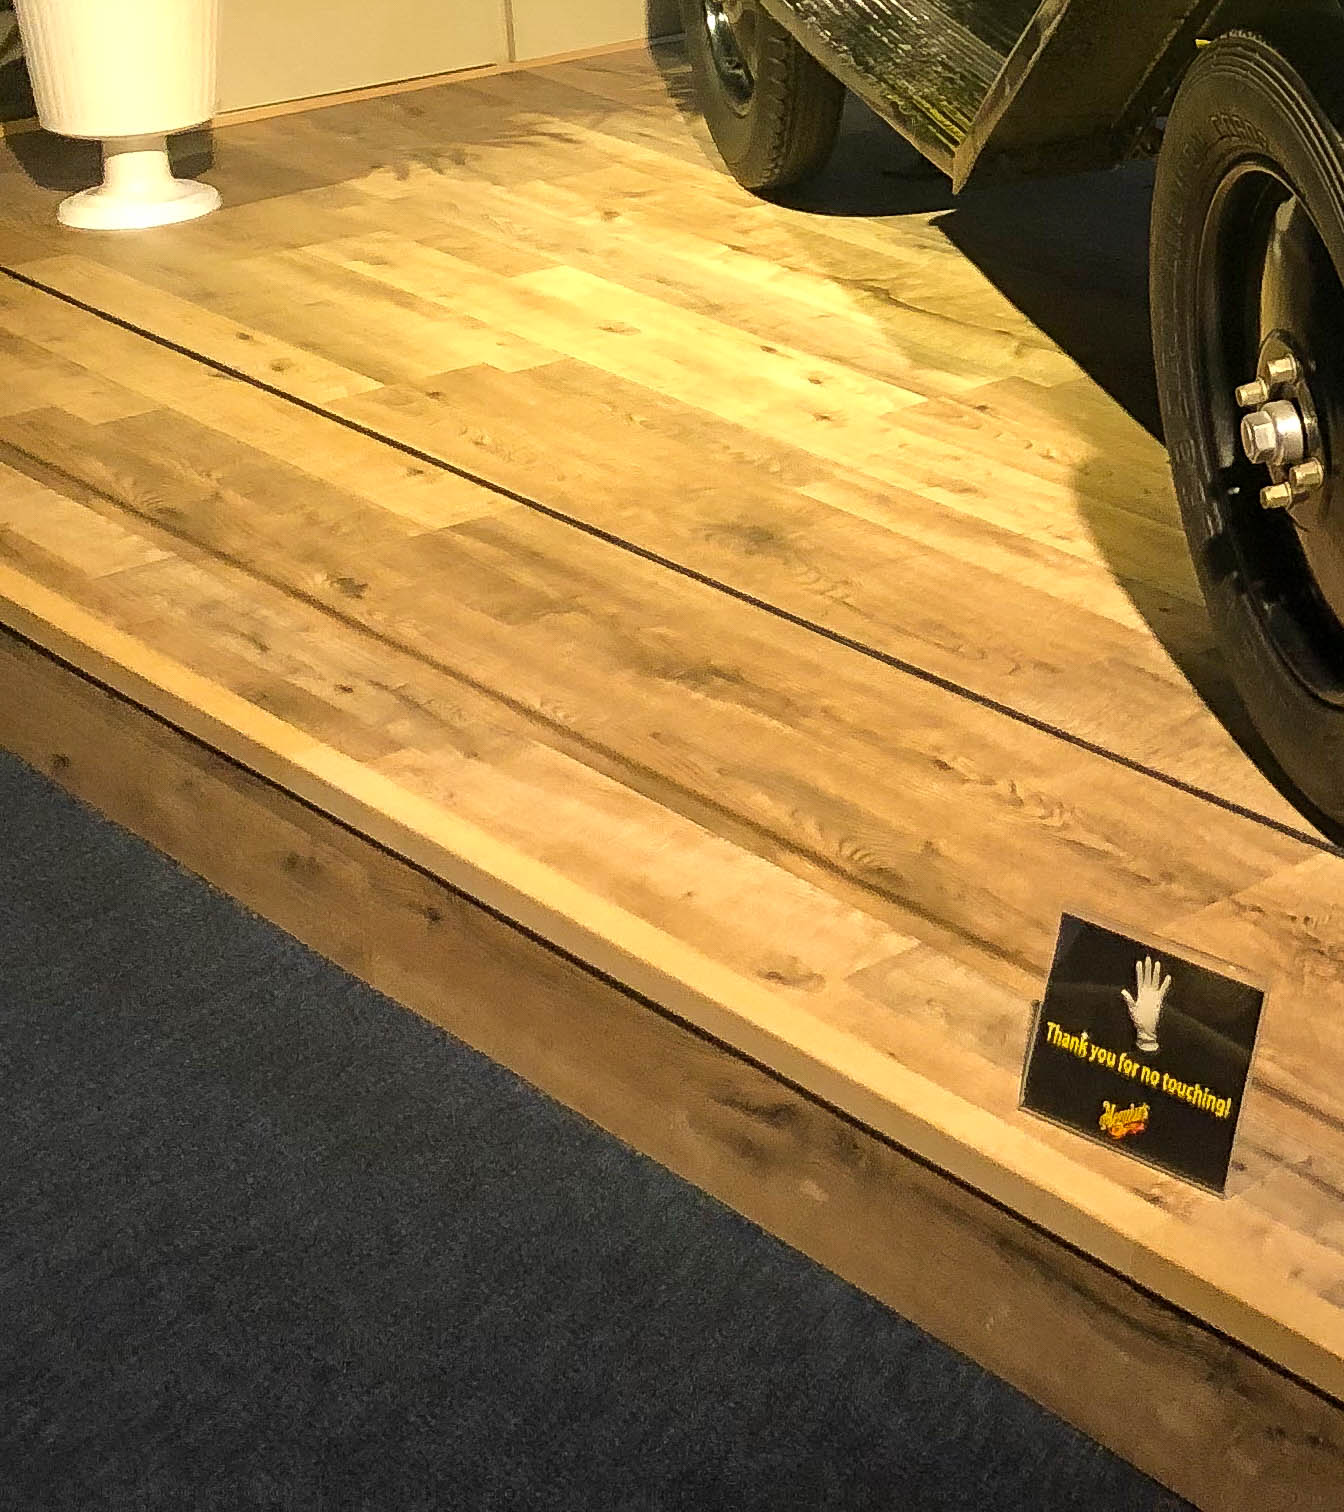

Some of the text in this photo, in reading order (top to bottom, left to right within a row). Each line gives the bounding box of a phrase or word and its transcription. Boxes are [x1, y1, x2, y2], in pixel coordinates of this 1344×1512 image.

[1047, 1021, 1232, 1118] Thank you for no touching!
